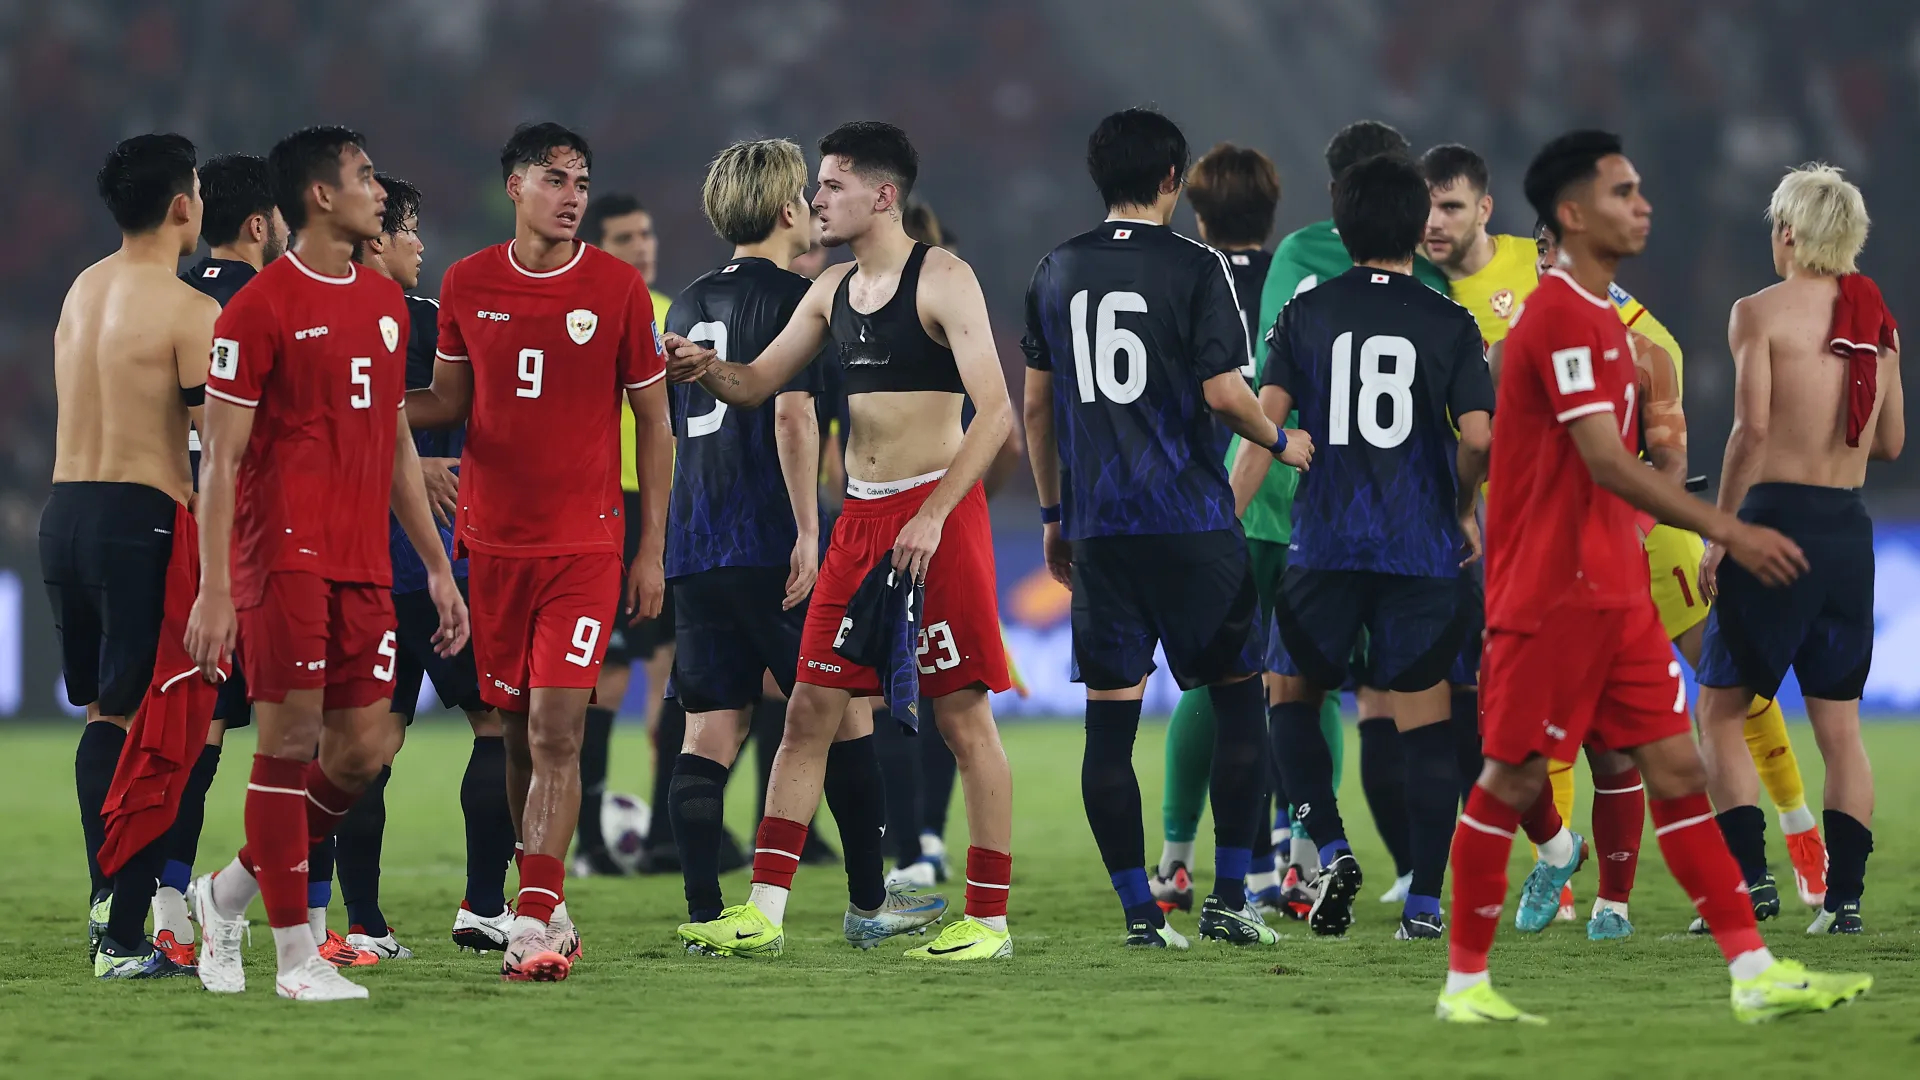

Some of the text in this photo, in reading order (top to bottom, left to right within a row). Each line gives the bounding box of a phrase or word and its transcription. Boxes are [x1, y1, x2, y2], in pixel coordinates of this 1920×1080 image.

[295, 325, 329, 340] erspo
[477, 310, 510, 322] erspo
[1069, 289, 1148, 405] 16
[351, 357, 372, 409] 5
[516, 348, 545, 399] 9
[1329, 331, 1417, 449] 18
[307, 659, 326, 671] ers
[372, 630, 397, 682] 5
[565, 616, 601, 668] 9
[807, 660, 842, 673] erspo
[915, 620, 961, 675] 23
[494, 679, 521, 696] erspo
